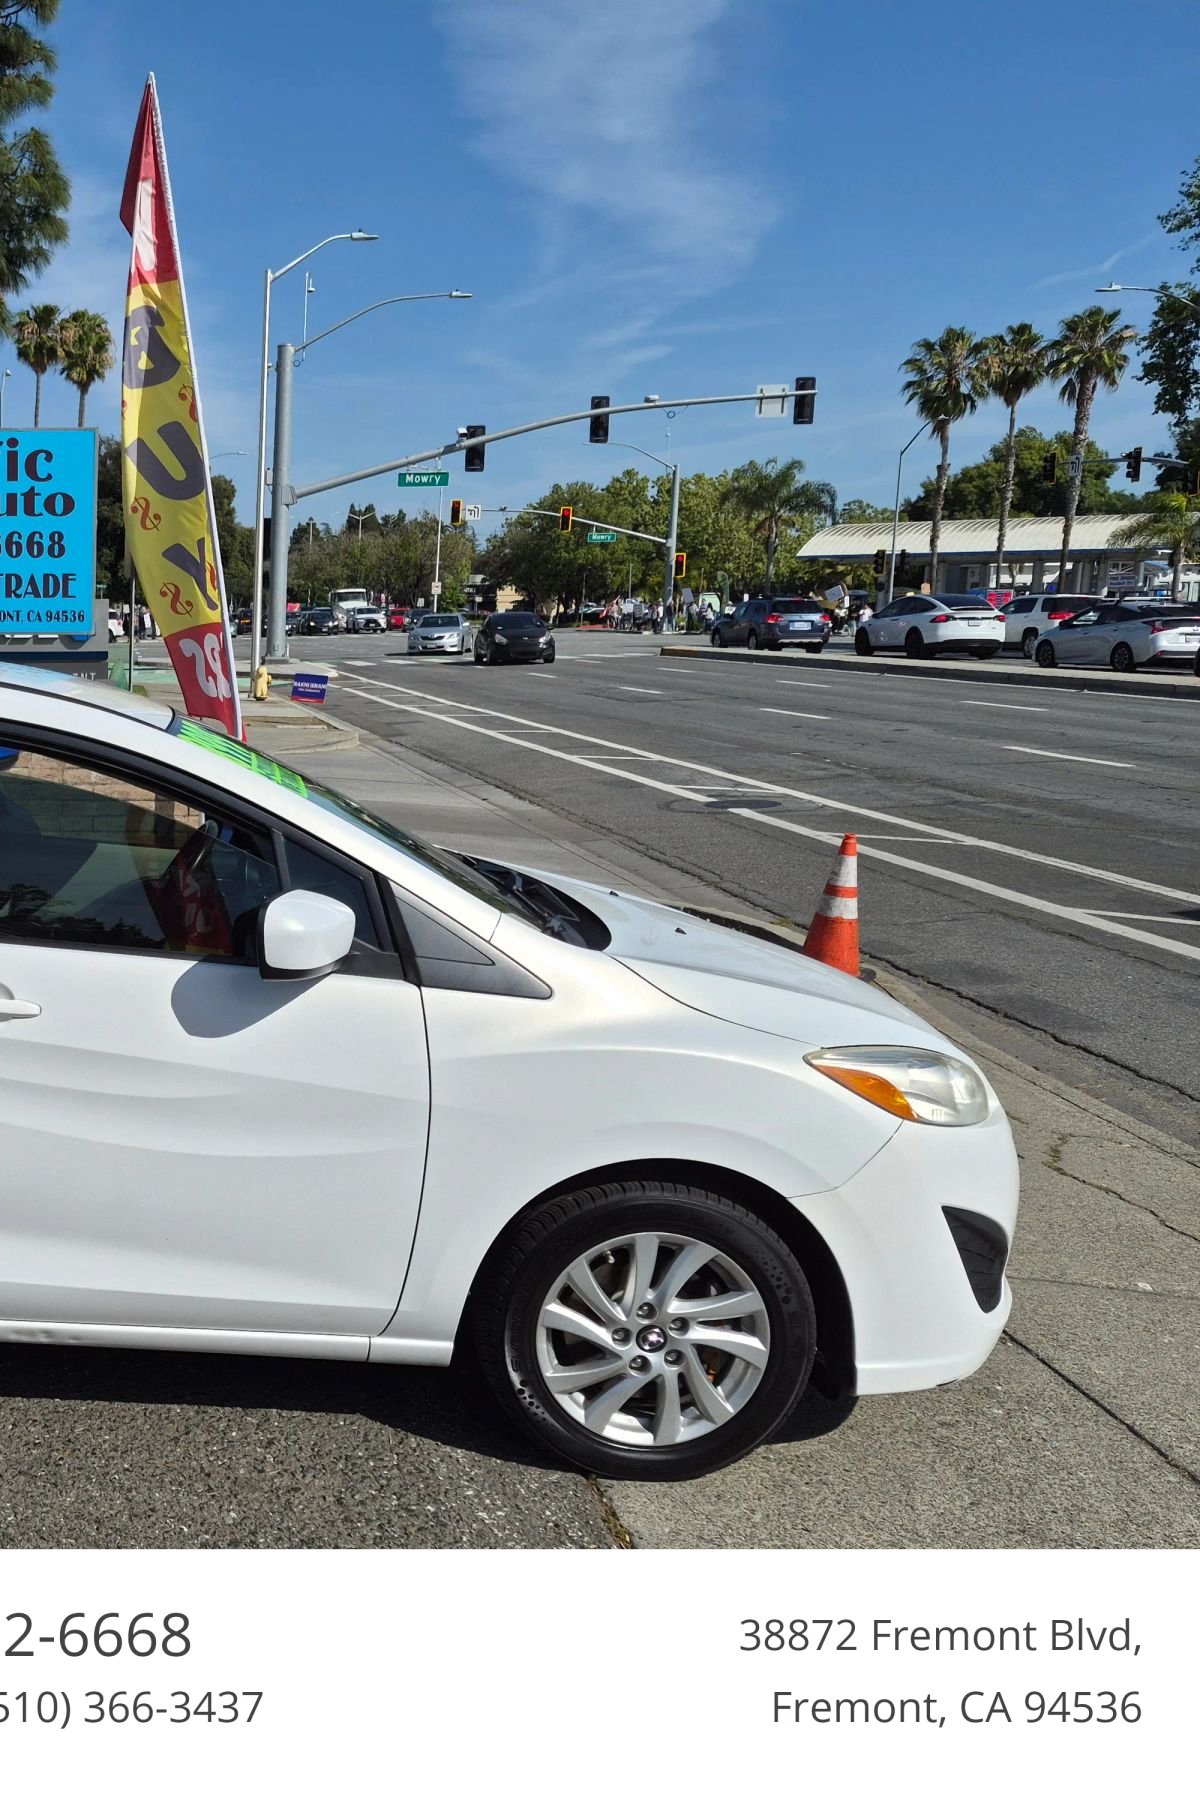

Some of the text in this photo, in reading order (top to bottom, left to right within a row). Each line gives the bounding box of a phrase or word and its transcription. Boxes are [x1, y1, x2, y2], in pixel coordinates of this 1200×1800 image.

[405, 473, 441, 485] Mowry
[592, 533, 612, 541] Mowry
[26, 609, 43, 622] CA
[45, 609, 85, 622] 94536
